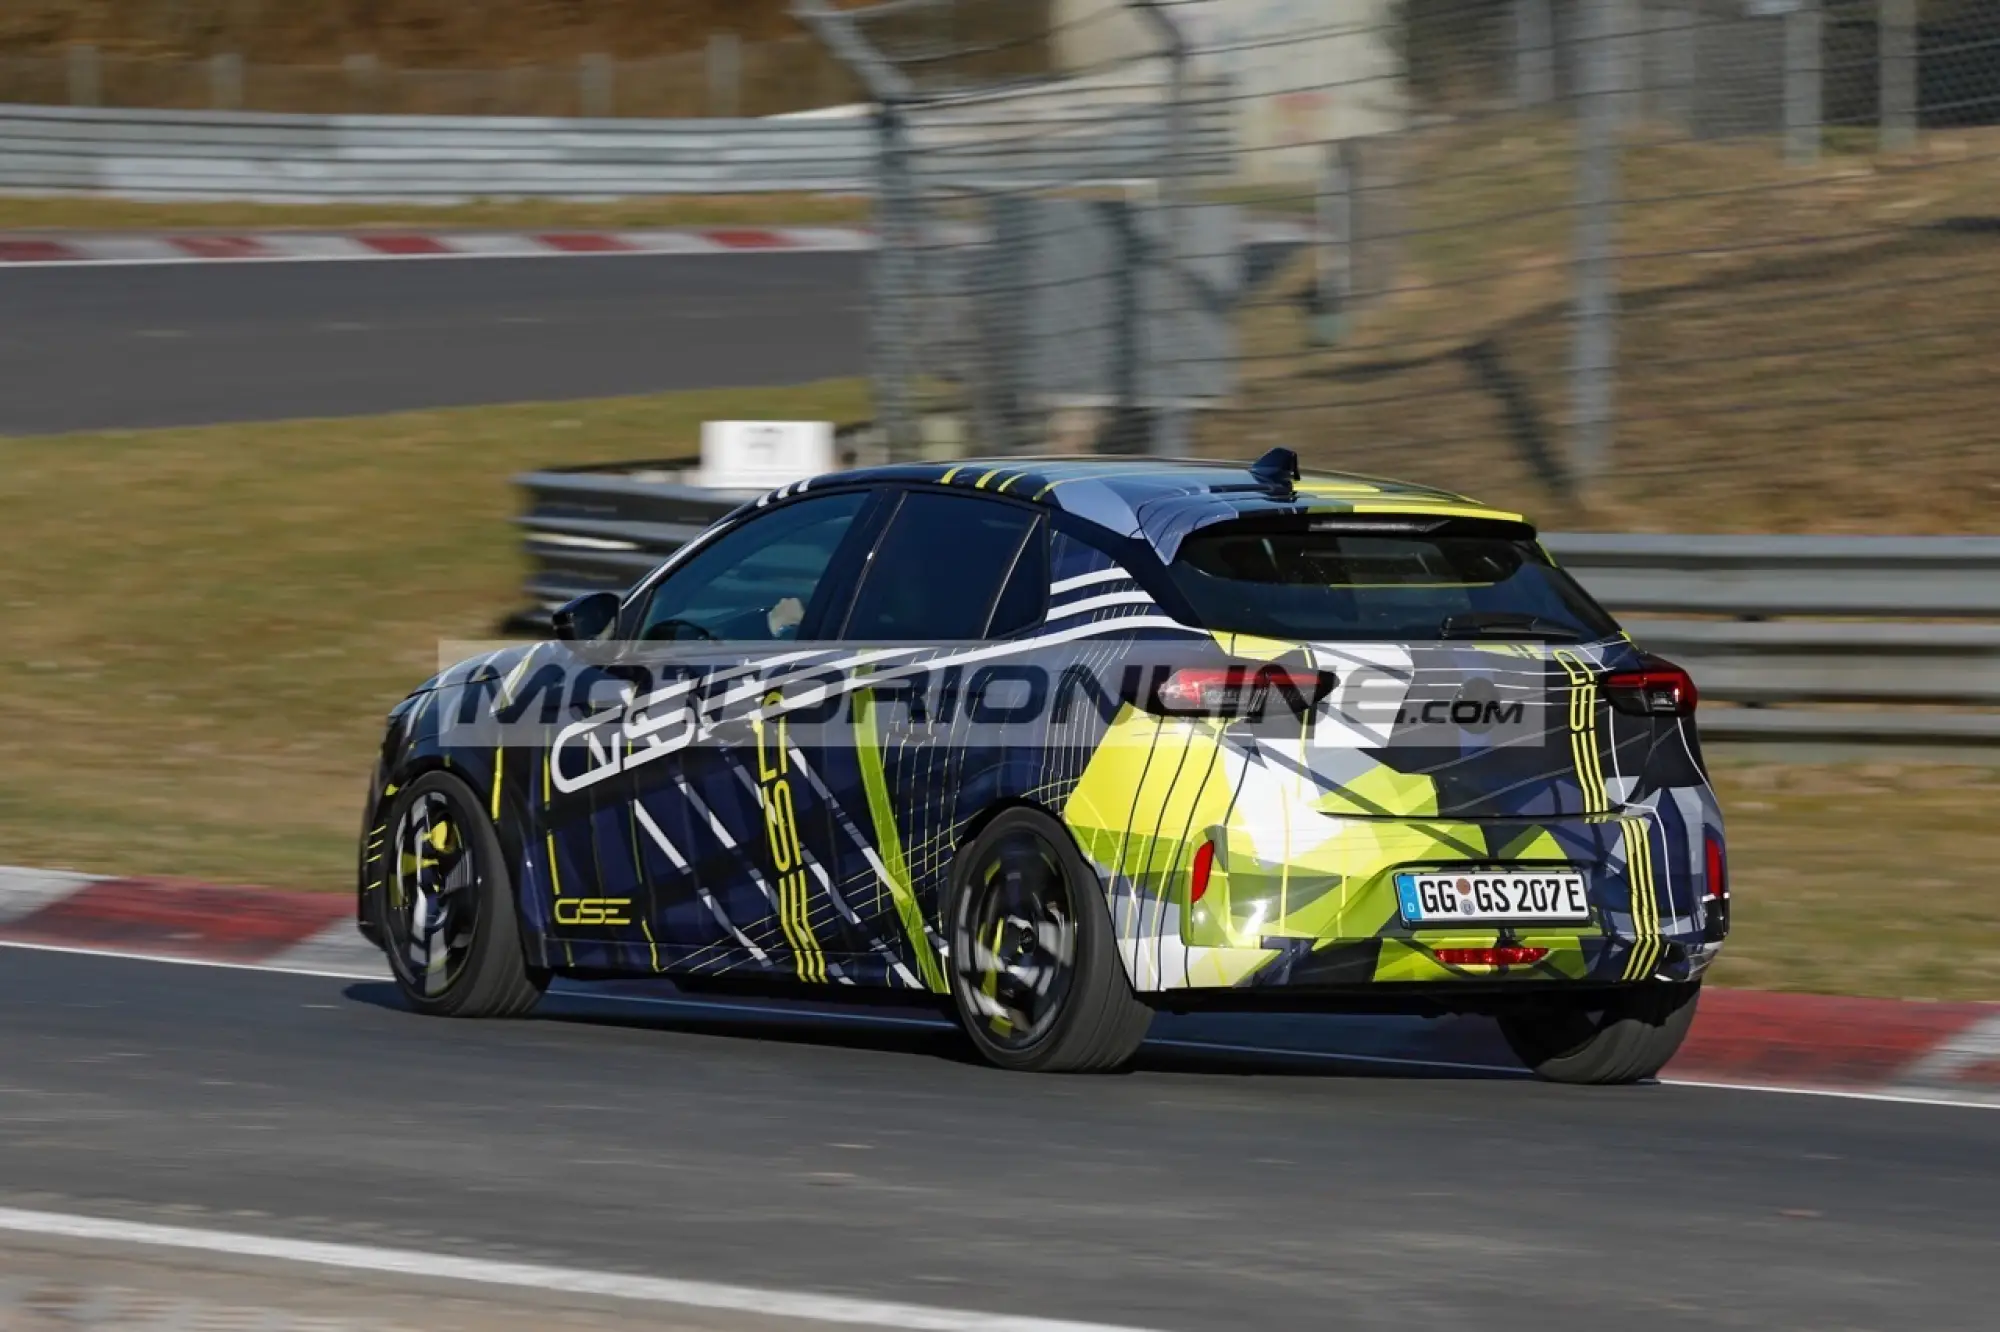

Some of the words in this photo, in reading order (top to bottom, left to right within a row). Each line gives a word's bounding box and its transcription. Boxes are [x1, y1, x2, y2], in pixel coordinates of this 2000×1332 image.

[1419, 880, 1457, 912] GG
[1473, 879, 1510, 912] GS
[554, 898, 632, 924] GSE
